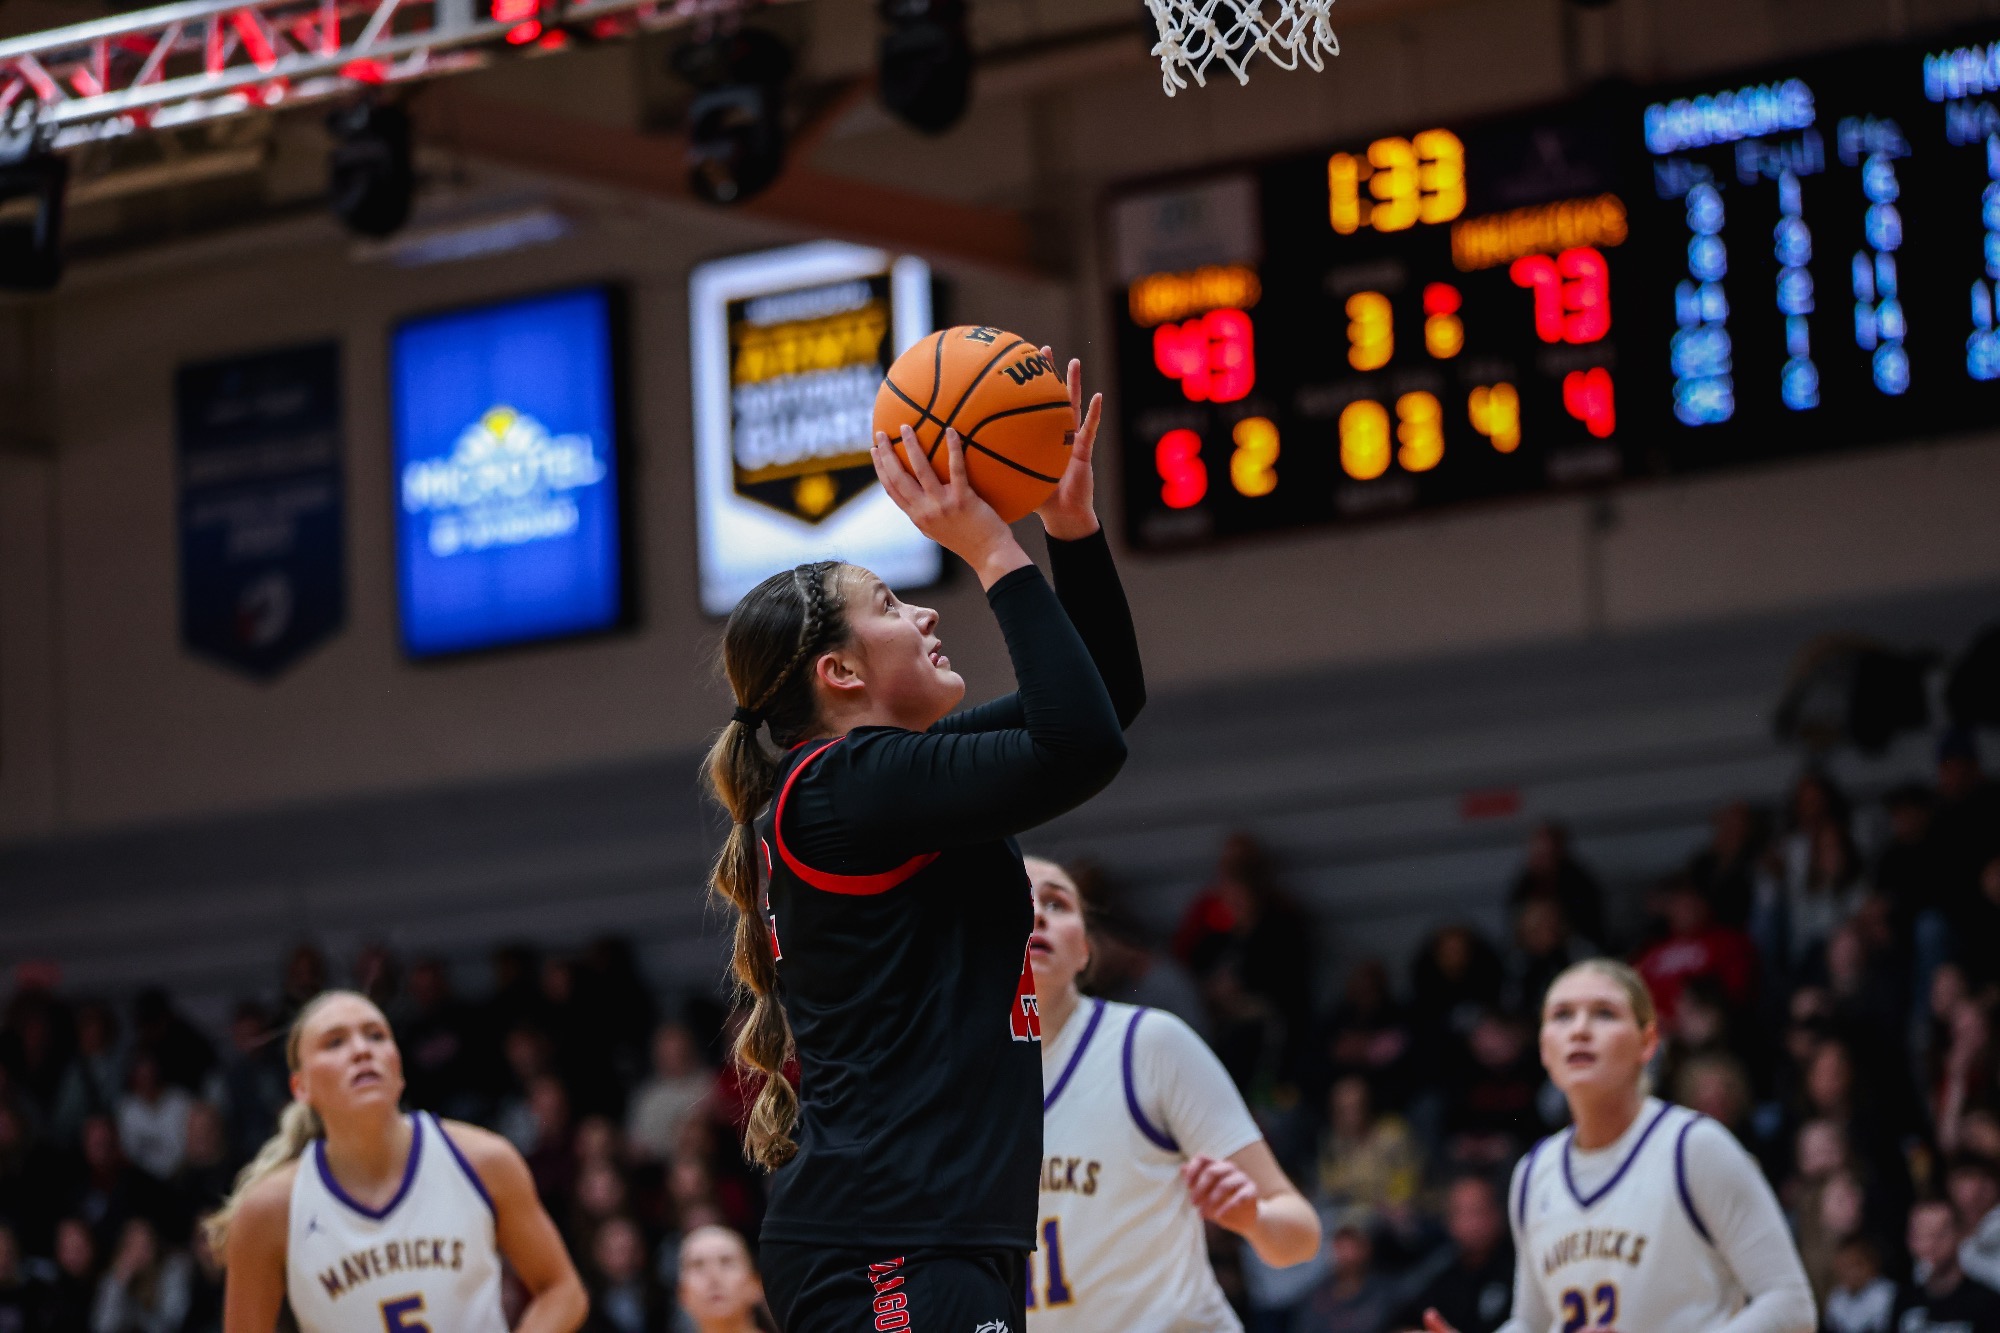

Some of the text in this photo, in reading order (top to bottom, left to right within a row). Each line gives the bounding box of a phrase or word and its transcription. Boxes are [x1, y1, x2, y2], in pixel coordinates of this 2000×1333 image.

[1346, 291, 1394, 371] 3
[1230, 417, 1279, 496] 2
[318, 1240, 465, 1301] MAVERICKS
